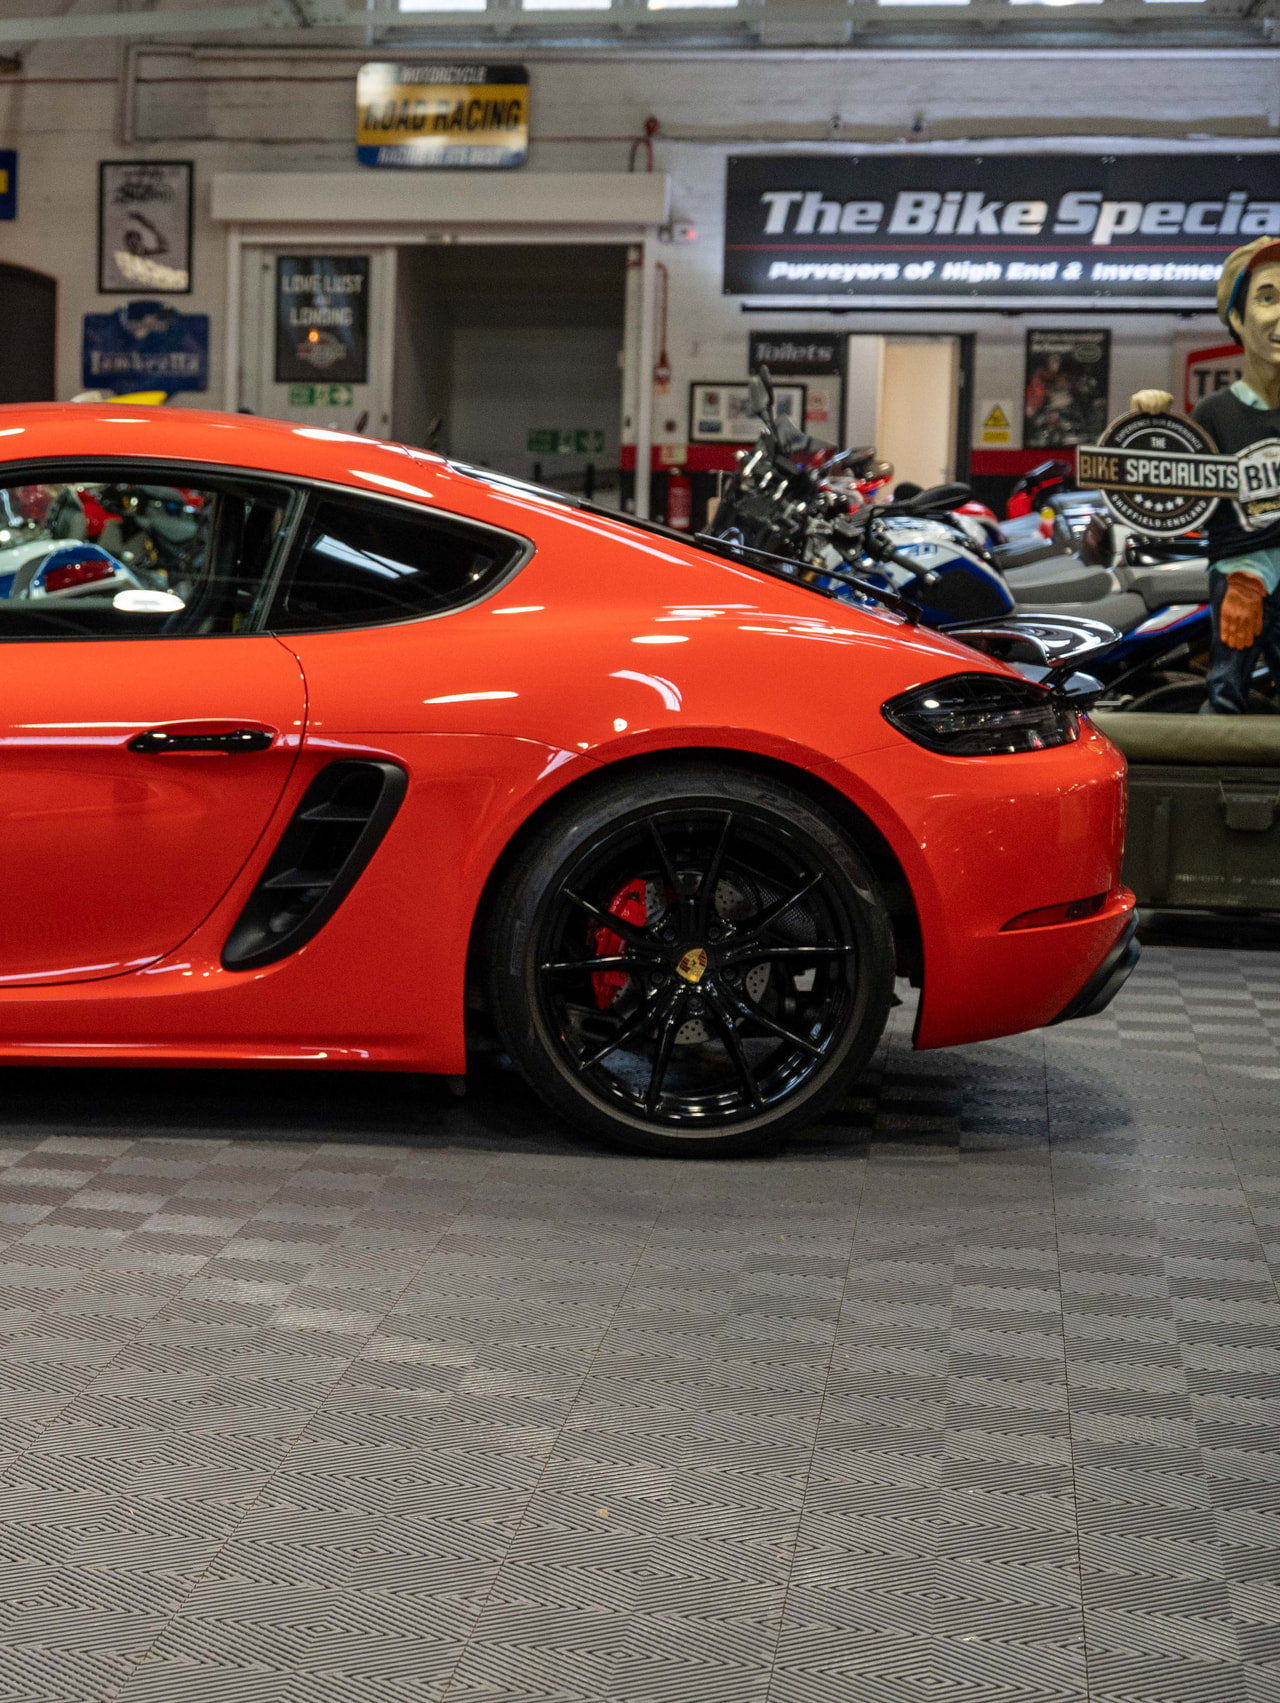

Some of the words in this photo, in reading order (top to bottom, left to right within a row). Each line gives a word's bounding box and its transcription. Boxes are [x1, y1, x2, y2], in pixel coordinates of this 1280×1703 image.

[432, 99, 523, 131] RACING
[761, 190, 885, 235] The
[887, 190, 1048, 235] Bike
[1053, 190, 1280, 245] Specia
[767, 260, 900, 283] Purveyors
[902, 260, 936, 281] of
[940, 261, 1003, 283] High
[1005, 262, 1060, 281] End
[1061, 261, 1084, 281] &
[756, 342, 834, 361] Toilets
[1149, 437, 1167, 449] THE
[1079, 455, 1120, 481] BIKE
[1125, 459, 1239, 489] SPECIALISTS
[1111, 494, 1162, 528] SHEFFIELD
[1166, 499, 1207, 528] ENGLAND
